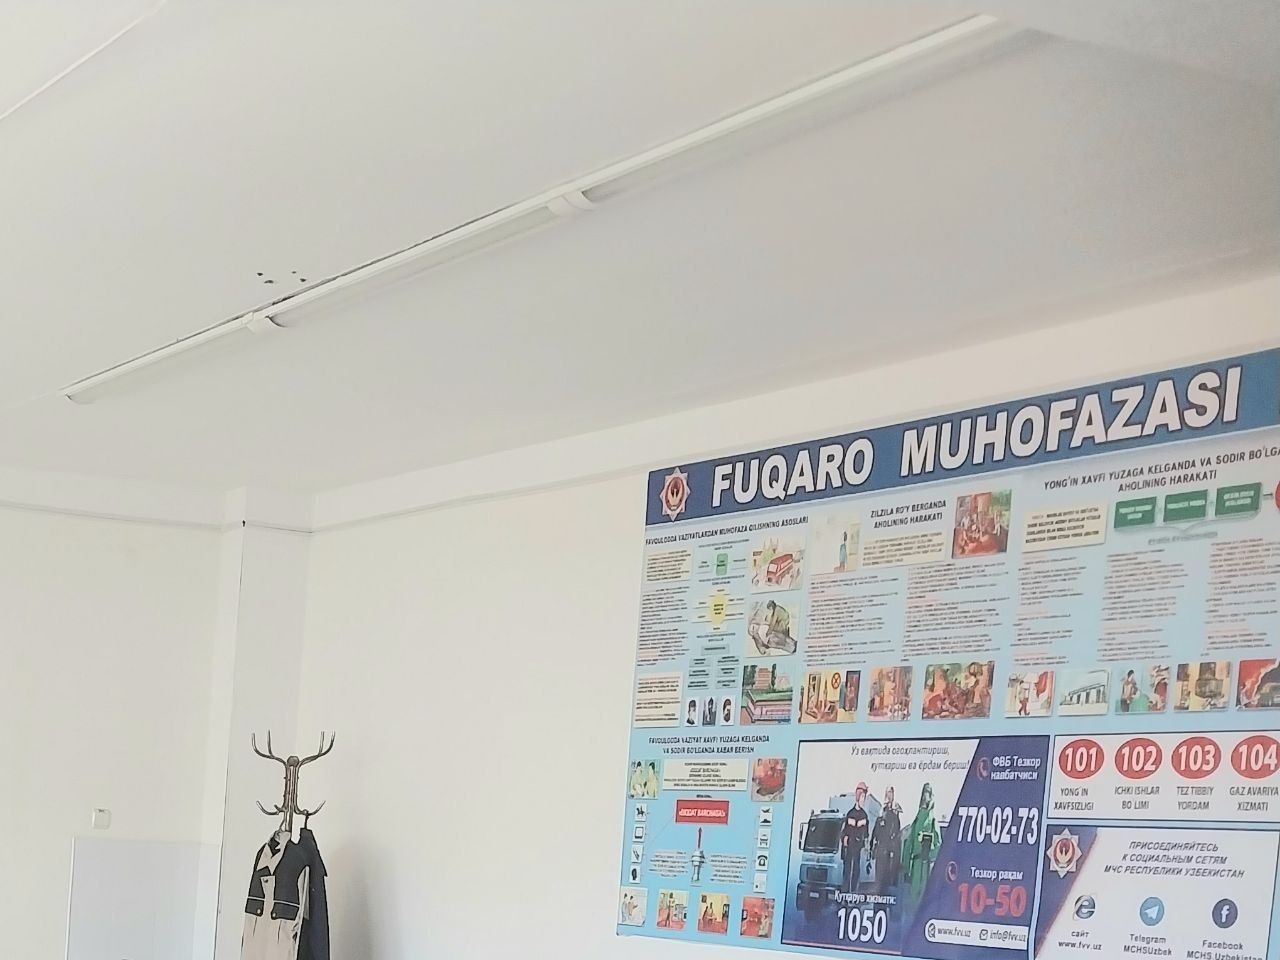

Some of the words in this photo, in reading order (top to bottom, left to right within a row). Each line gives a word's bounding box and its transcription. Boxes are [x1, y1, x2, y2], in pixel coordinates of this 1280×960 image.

[711, 438, 874, 507] FUQARO
[900, 367, 1242, 477] MUHOFAZASI
[1044, 476, 1078, 490] YONG'IN
[1081, 472, 1105, 484] XAVFI
[1109, 467, 1144, 481] YUZAGA
[1148, 459, 1196, 475] KELGANDA
[1200, 457, 1212, 467] VA
[1216, 451, 1245, 464] SODIR
[1249, 446, 1280, 459] BO'LG
[1118, 477, 1167, 493] AHOLINING
[1169, 469, 1217, 485] HARAKATI
[870, 505, 894, 518] ZILZILA
[912, 500, 946, 512] BERGANDA
[874, 516, 908, 529] AHOLINING
[910, 512, 942, 524] HARAKATI
[992, 755, 1011, 767] ФВБ
[1012, 755, 1041, 769] Тезкор
[1064, 746, 1097, 772] 101
[1121, 745, 1158, 771] 102
[1177, 745, 1215, 771] 103
[1237, 743, 1278, 771] 104
[991, 769, 1038, 780] навбатчиси
[1115, 786, 1133, 795] ICHKI
[1134, 786, 1160, 795] ISHLAR
[1177, 786, 1189, 795] TEZ
[1229, 786, 1246, 796] GAZ
[1247, 786, 1279, 796] AVARIYA
[1054, 802, 1094, 811] XAVFSIZLIGI
[1178, 801, 1209, 810] YORDAM
[1237, 801, 1268, 811] XIZMATI
[957, 805, 1039, 845] 770-02-73
[1129, 840, 1219, 852] ПРИСОЕДИНЯЙТЕСЬ
[1122, 853, 1128, 861] К
[1129, 853, 1194, 863] СОЦИАЛЬНЫМ
[1195, 855, 1228, 865] СЕТЯМ
[970, 866, 997, 881] Тезкор
[1104, 864, 1123, 874] МЧС
[1124, 865, 1182, 875] РЕСПУБЛИКИ
[1183, 868, 1245, 878] УЗБЕКИСТАН
[959, 883, 1027, 917] 10-50
[837, 907, 887, 943] 1050
[1071, 929, 1090, 938] сайт
[1130, 933, 1167, 945] Telegram
[1058, 940, 1102, 950] www.fvv.uz
[1123, 945, 1172, 956] MCHSUzbek
[1202, 939, 1243, 950] Facebook
